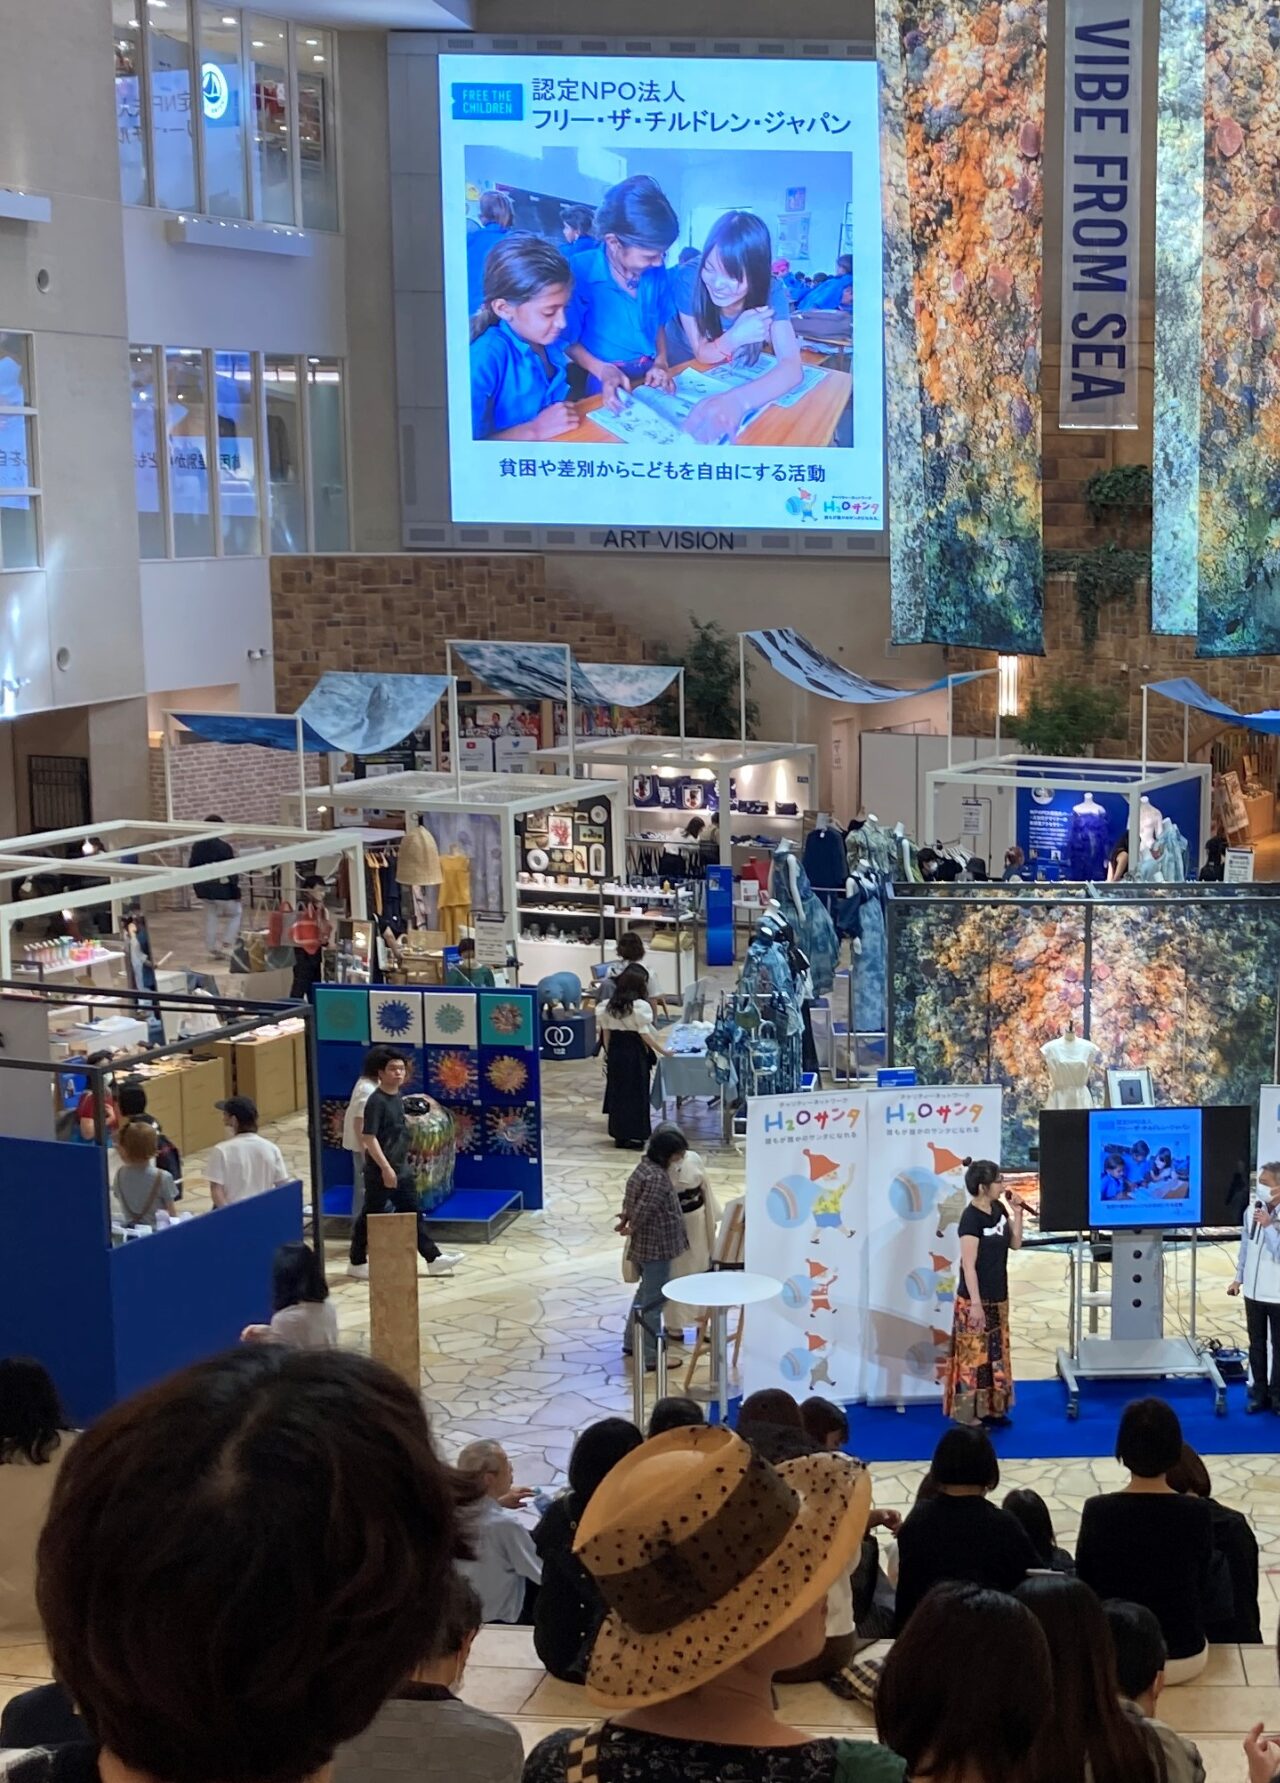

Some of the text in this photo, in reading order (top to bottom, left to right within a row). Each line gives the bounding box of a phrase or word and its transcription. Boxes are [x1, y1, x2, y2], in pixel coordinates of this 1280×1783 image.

[463, 90, 512, 102] FREE THE
[532, 78, 686, 103] 認定NPO法人
[463, 102, 512, 114] CHILDREN
[532, 108, 852, 135] フリー・ザ・チルドレン・ジャパン
[1071, 19, 1130, 402] VIBE FROM SEA
[499, 458, 826, 483] 貧困や差別からこどもを自由にする活動
[604, 529, 735, 550] ART VISION
